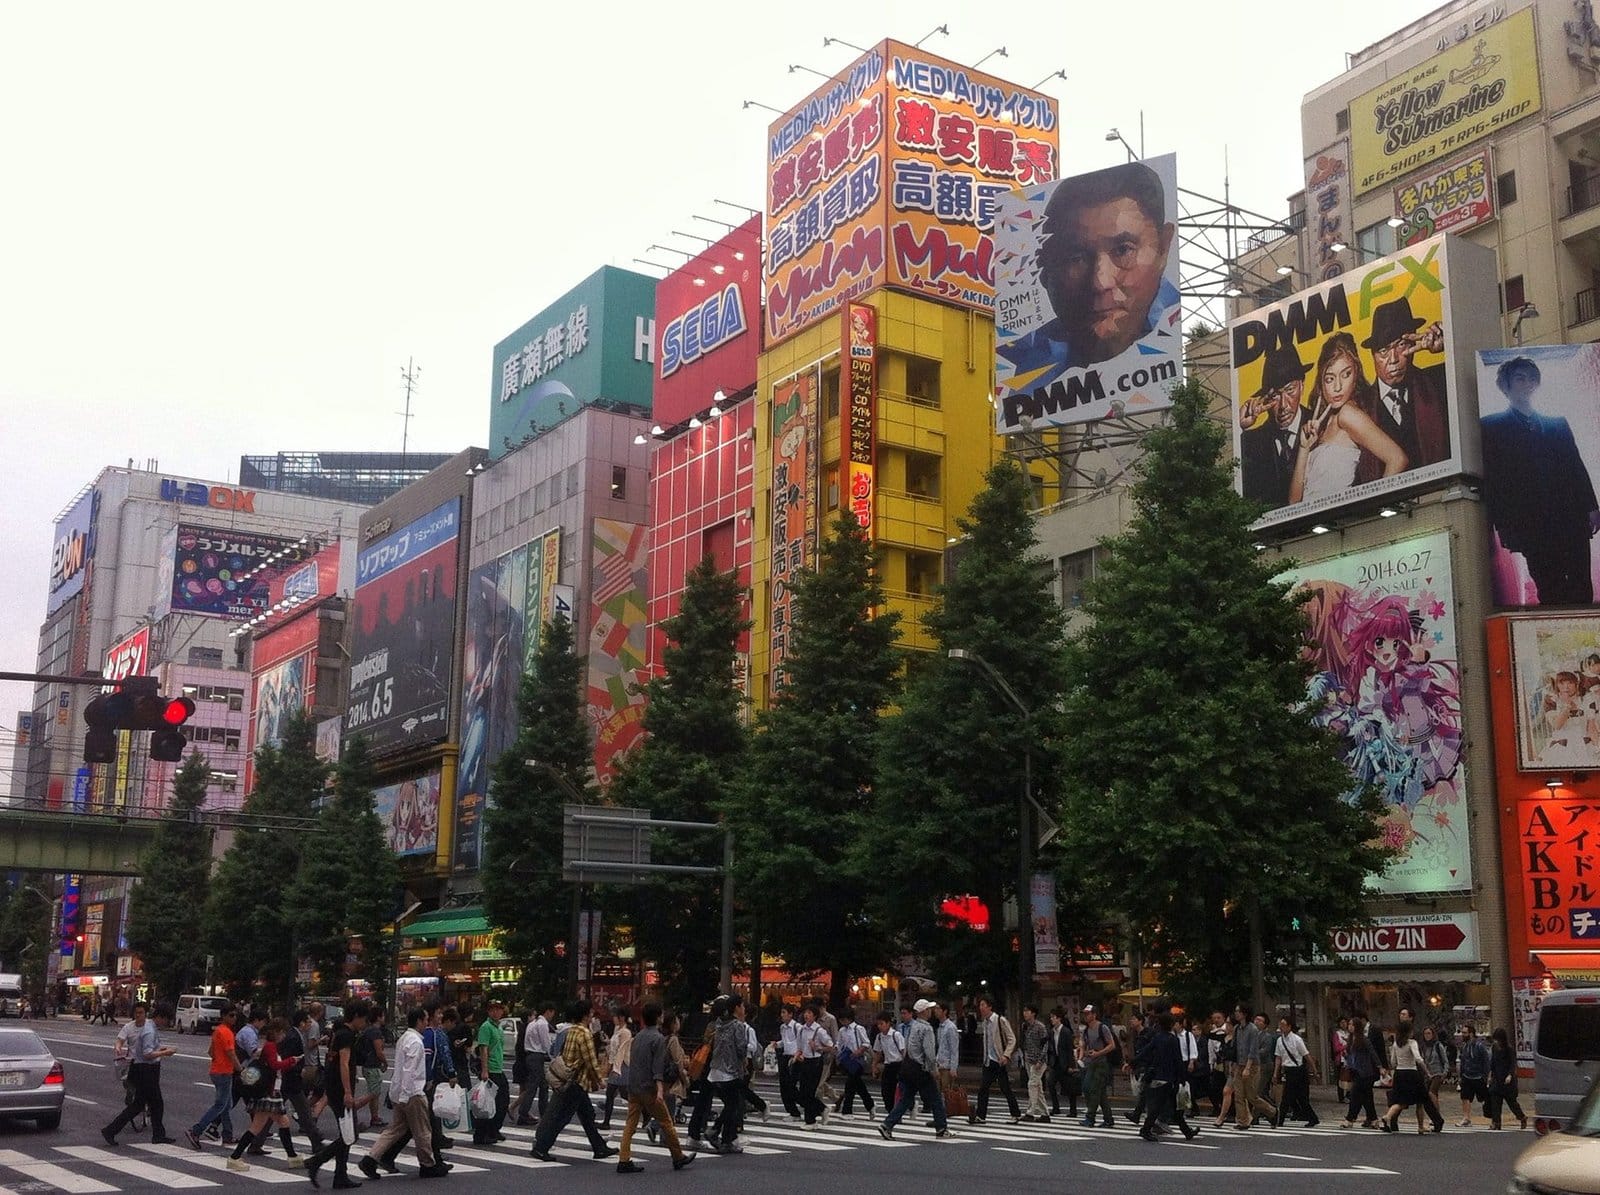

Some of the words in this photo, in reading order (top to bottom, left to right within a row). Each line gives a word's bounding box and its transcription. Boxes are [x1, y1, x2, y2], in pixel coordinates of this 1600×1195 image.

[1376, 82, 1408, 102] HOBBY
[1413, 65, 1439, 83] BASE
[1375, 80, 1445, 133] Yellow
[1384, 79, 1505, 155] Submarine
[896, 98, 1052, 184] 激安販売
[1400, 157, 1485, 214] まんが喫茶
[769, 153, 879, 274] 高額買取
[910, 274, 961, 297] ムーラン
[811, 297, 836, 318] AKIBA
[1000, 292, 1031, 311] DMM
[1001, 309, 1019, 322] 3D
[1232, 283, 1351, 369] DMM
[1358, 243, 1446, 321] FX
[661, 283, 747, 379] SEGA
[1002, 316, 1033, 332] PRINT
[852, 360, 871, 372] DVD
[852, 383, 871, 395] ゲーム
[855, 394, 868, 405] CD
[852, 417, 871, 428] アニメ
[360, 532, 411, 578] ソフマップ
[1358, 550, 1432, 585] 2014.6.27
[1392, 577, 1418, 592] SALE
[1563, 805, 1597, 903] アイドル
[1328, 928, 1390, 951] OMIC
[1395, 927, 1426, 950] ZIN
